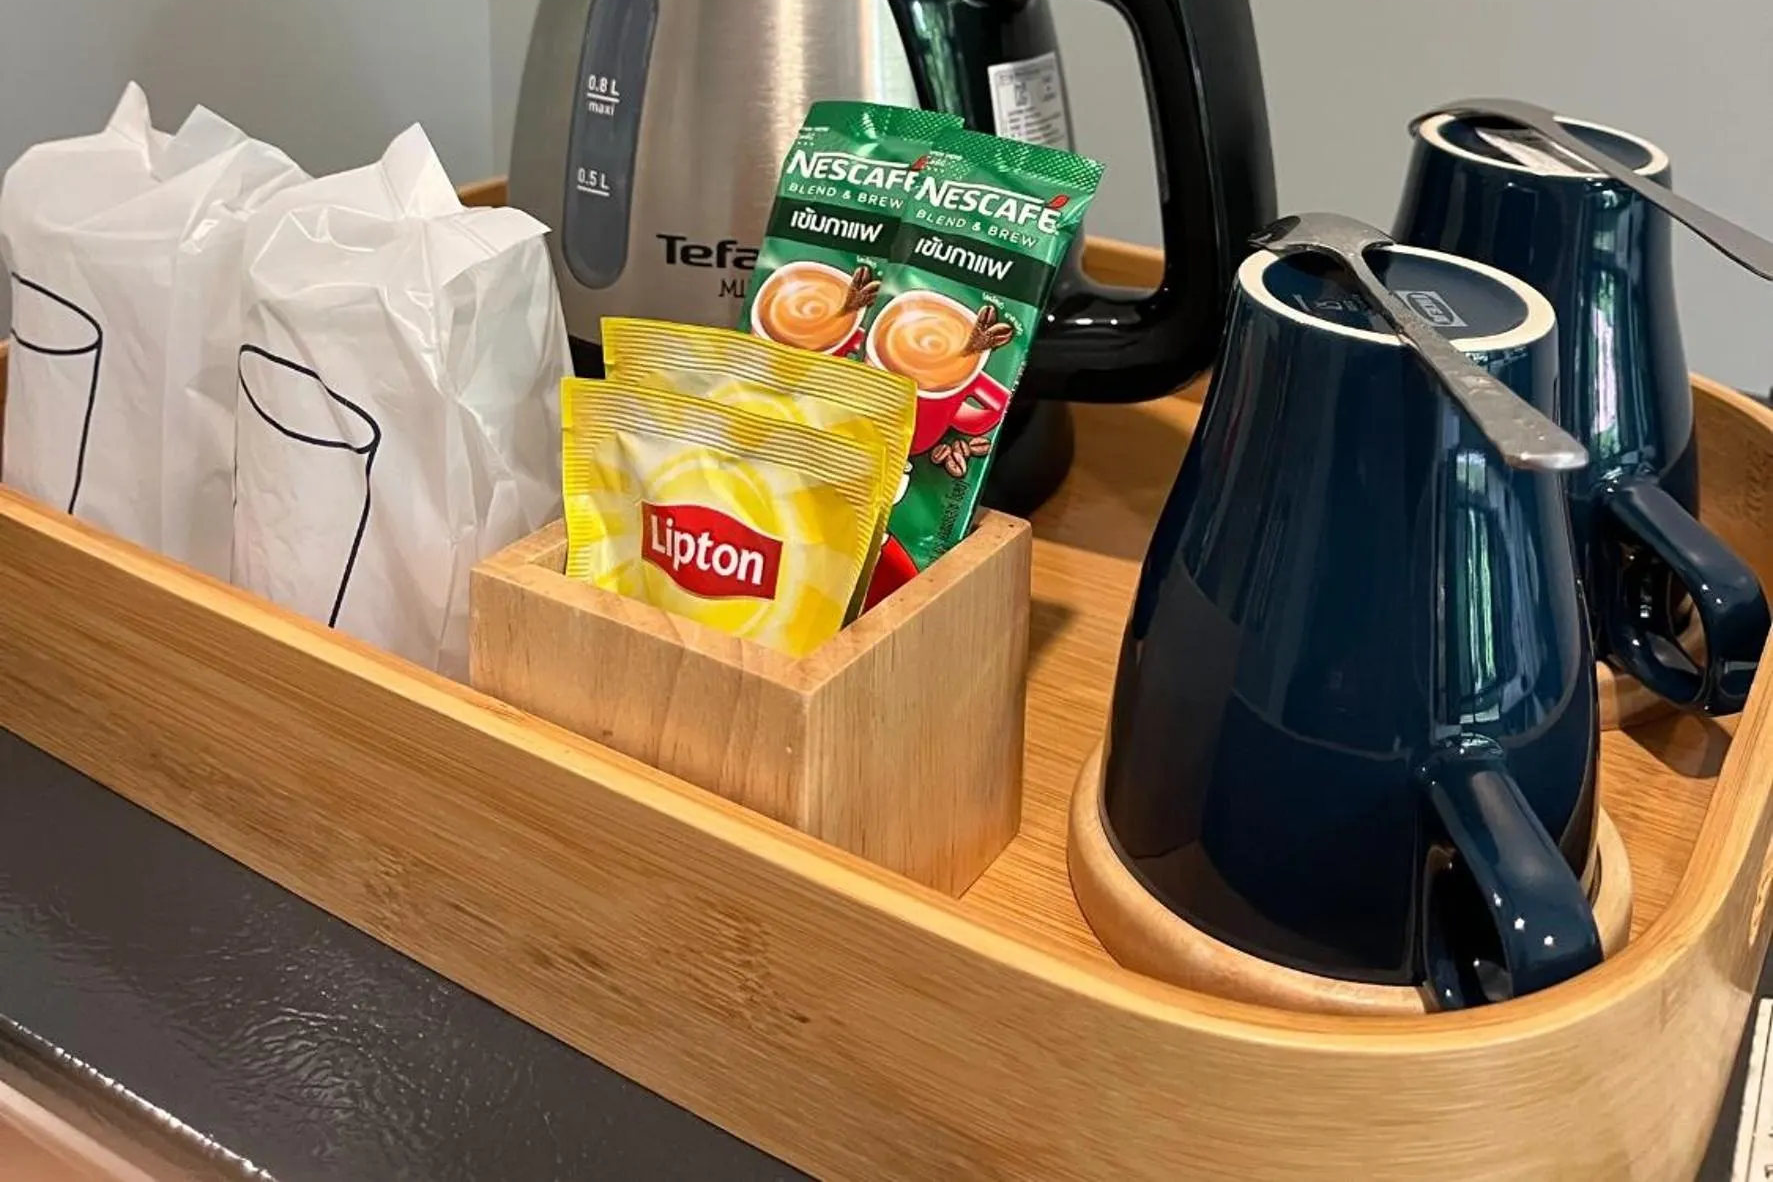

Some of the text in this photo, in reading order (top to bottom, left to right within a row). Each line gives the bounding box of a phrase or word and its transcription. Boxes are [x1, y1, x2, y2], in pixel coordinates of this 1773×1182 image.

[587, 74, 620, 96] 0.8 L
[588, 101, 615, 116] maxi
[577, 167, 610, 190] 0.5 L
[788, 182, 904, 210] BLEND & BREW
[915, 209, 1038, 249] BLEND & BREW
[655, 233, 760, 271] Tefa
[650, 513, 765, 586] Lipton
